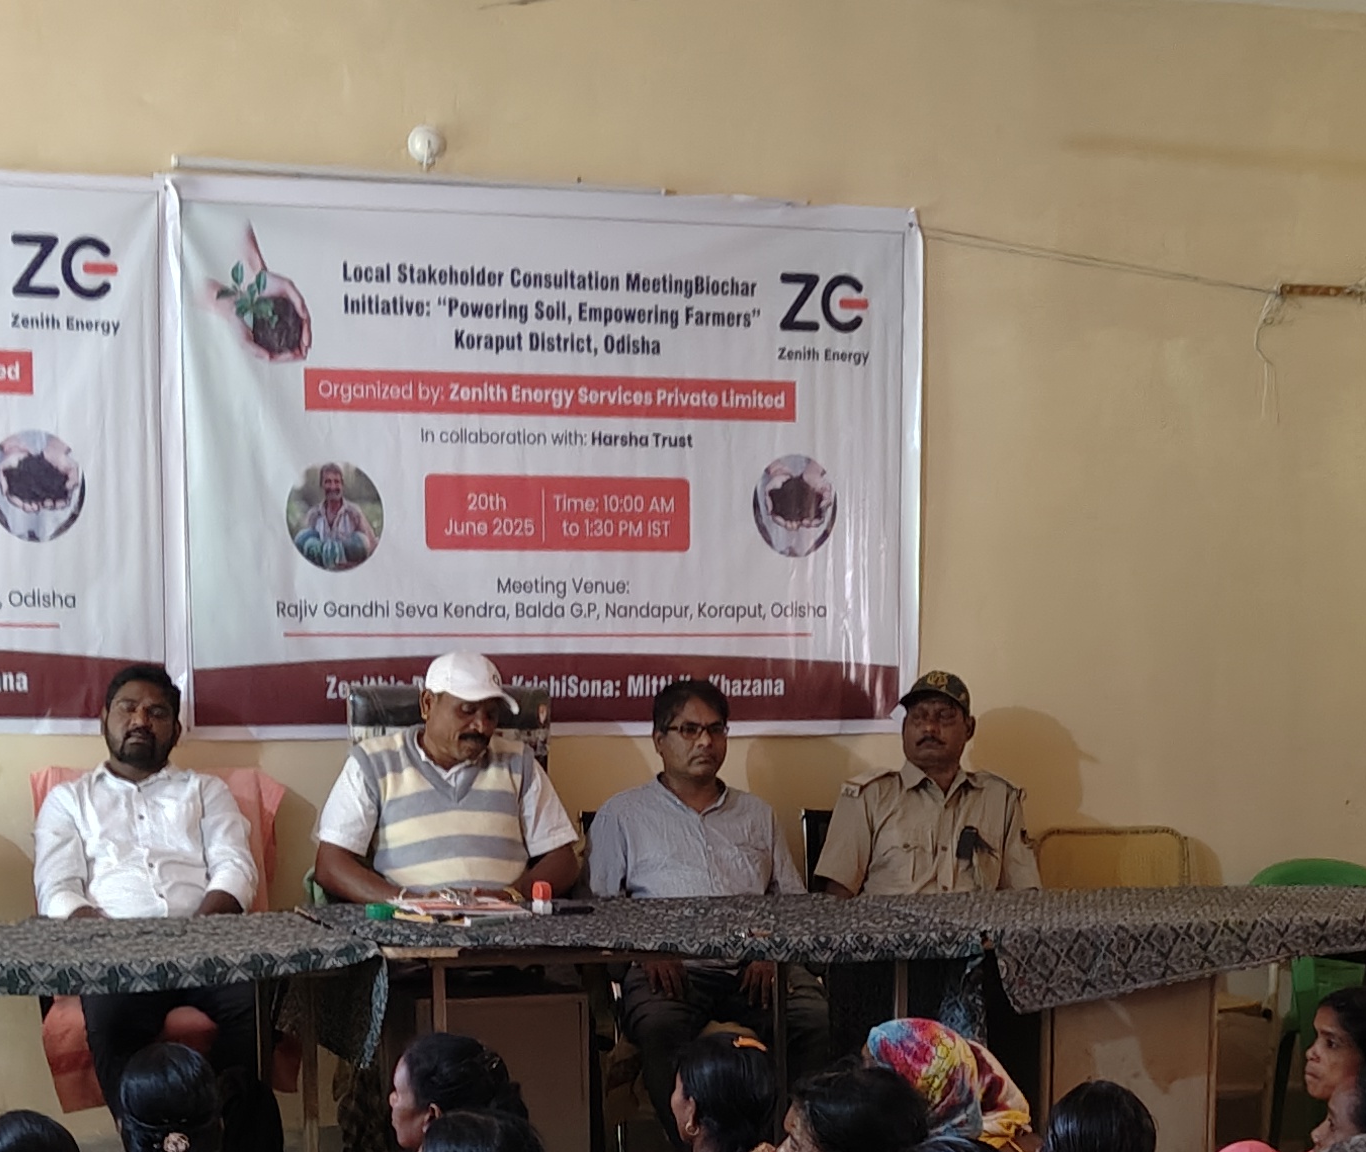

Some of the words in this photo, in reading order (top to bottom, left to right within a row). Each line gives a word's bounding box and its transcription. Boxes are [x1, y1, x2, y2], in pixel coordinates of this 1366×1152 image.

[342, 260, 391, 284] Local
[397, 263, 505, 287] Stakeholder
[510, 267, 620, 292] Consultation
[625, 272, 757, 300] MeetingBiochar
[343, 293, 431, 317] Initiative:
[534, 300, 573, 325] Soil,
[578, 301, 679, 330] Empowering
[11, 312, 61, 330] Zenith
[65, 315, 121, 337] Energy
[454, 329, 523, 355] Koraput
[528, 331, 598, 357] District,
[603, 333, 661, 356] Odisha
[777, 345, 820, 362] Zenith
[824, 347, 870, 367] Energy
[318, 379, 413, 404] Organized
[417, 381, 445, 406] by:
[449, 381, 508, 402] Zenith
[511, 384, 575, 409] Energy
[577, 384, 653, 406] Services
[656, 387, 719, 408] Private
[721, 387, 786, 409] Limited
[420, 427, 435, 443] In
[439, 427, 548, 446] collaboration
[550, 429, 588, 447] with:
[591, 430, 649, 448] Harsha
[652, 432, 693, 449] Trust
[467, 492, 507, 512] 20th
[552, 493, 599, 513] Time:
[602, 494, 645, 513] 10:00
[648, 496, 675, 514] AM
[444, 517, 488, 536] June
[492, 516, 535, 537] 2025
[561, 519, 580, 537] to
[584, 518, 614, 538] 1:30
[617, 519, 644, 538] PM
[647, 519, 671, 538] IST
[8, 588, 77, 609] Odisha
[496, 575, 567, 600] Meeting
[571, 576, 630, 595] Venue:
[276, 599, 319, 624] Rajiv
[323, 599, 390, 619] Gandhi
[395, 601, 438, 619] Seva
[443, 601, 510, 621] Kendra,
[515, 600, 566, 619] Balda
[569, 601, 600, 621] G.P,
[604, 601, 693, 624] Nandapur,
[697, 601, 767, 624] Koraput,
[770, 600, 828, 619] Odisha
